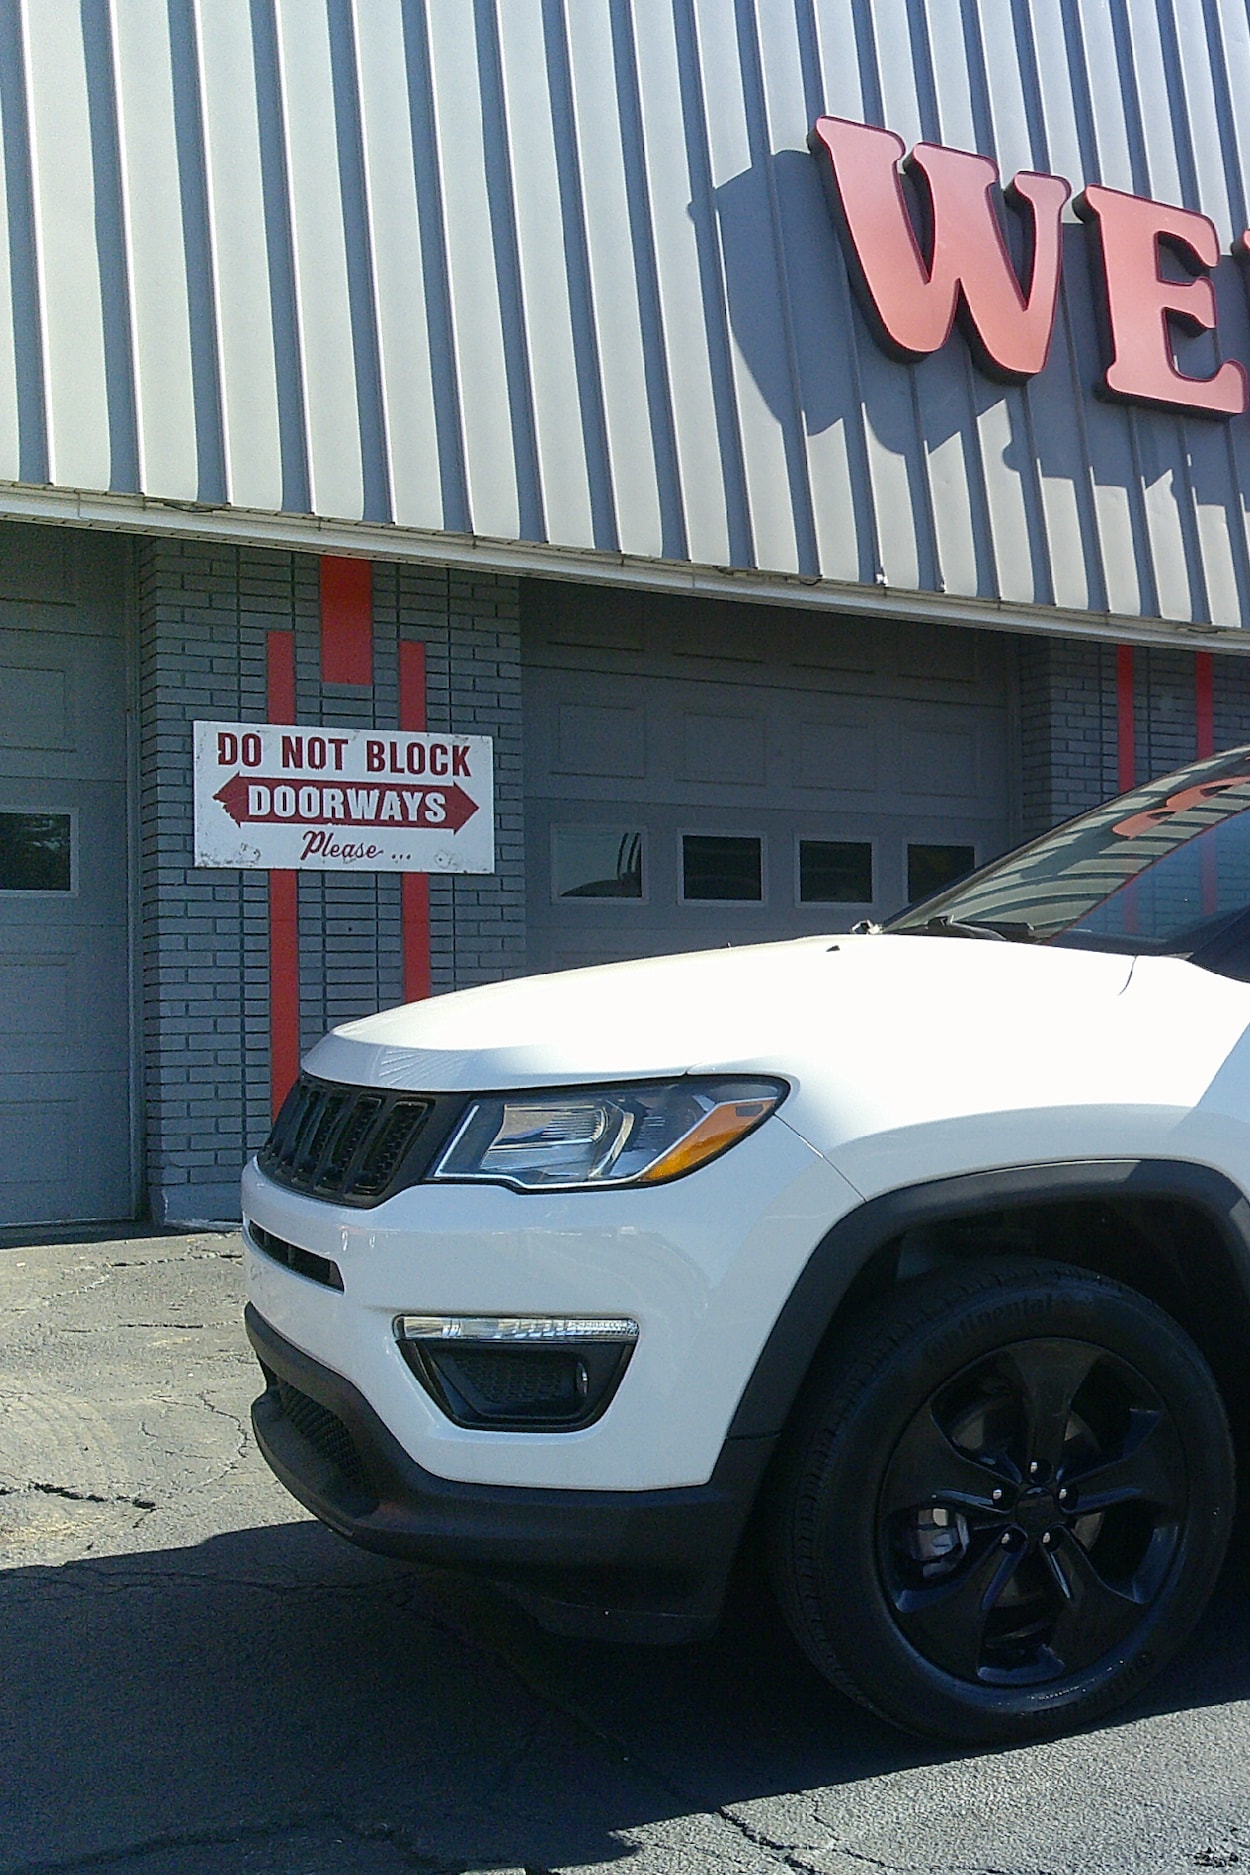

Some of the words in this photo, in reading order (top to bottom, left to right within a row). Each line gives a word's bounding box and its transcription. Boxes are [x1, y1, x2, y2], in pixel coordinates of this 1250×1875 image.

[217, 732, 262, 767] DO
[281, 736, 349, 771] NOT
[366, 740, 472, 777] BLOCK
[248, 784, 446, 822] DOORWAYS
[300, 830, 384, 861] Please
[925, 1293, 1052, 1363] tinental
